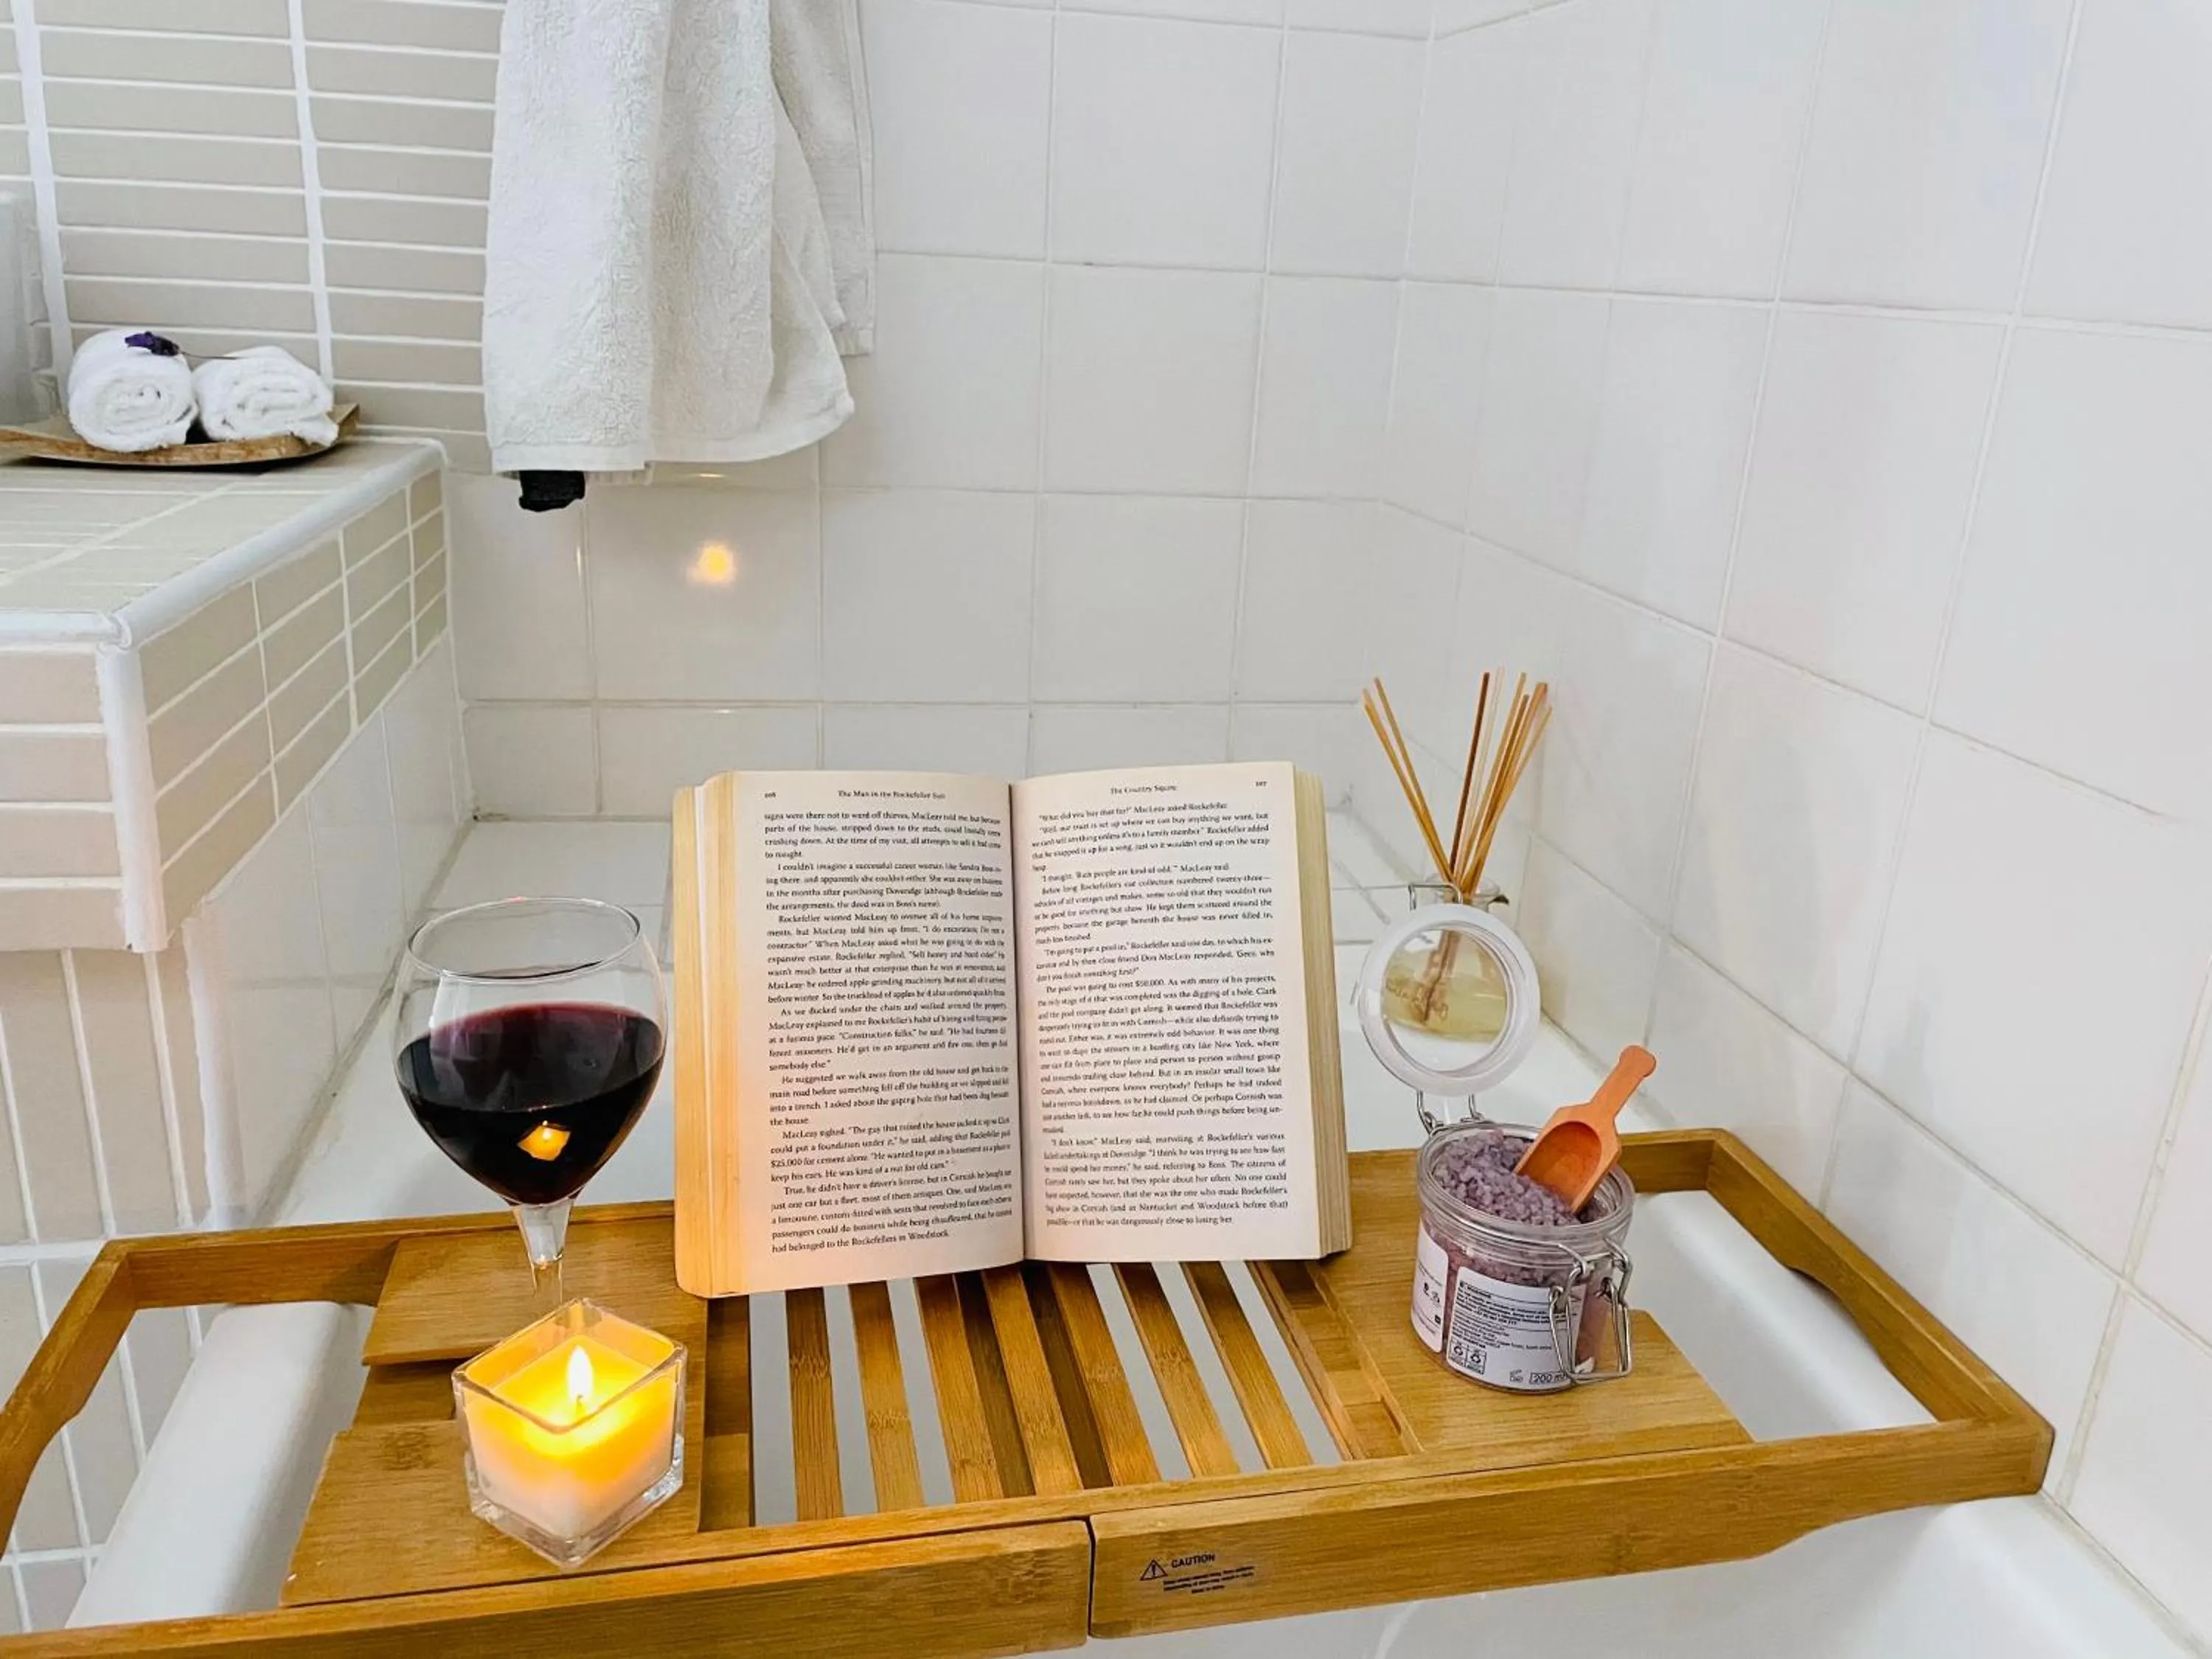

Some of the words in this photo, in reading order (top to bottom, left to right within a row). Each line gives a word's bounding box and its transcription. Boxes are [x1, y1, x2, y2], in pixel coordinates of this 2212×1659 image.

[1187, 815, 1220, 824] anything
[764, 825, 785, 834] parts
[786, 824, 796, 832] of
[782, 862, 814, 870] couldn't
[1206, 888, 1222, 897] they
[854, 964, 869, 973] that
[1124, 991, 1161, 1001] completed
[808, 1006, 837, 1014] ducked
[880, 1004, 902, 1012] chain
[804, 1018, 843, 1030] explained
[1166, 1029, 1181, 1037] odd
[1258, 1026, 1279, 1035] thing
[768, 1061, 809, 1071] somebody
[1122, 1057, 1142, 1067] place
[1197, 1055, 1223, 1063] person
[1222, 1066, 1244, 1074] small
[781, 1076, 793, 1084] He
[795, 1074, 834, 1084] suggested
[792, 1088, 810, 1096] road
[811, 1087, 837, 1095] before
[838, 1085, 879, 1094] something
[905, 1082, 918, 1090] the
[1203, 1093, 1234, 1103] perhaps
[1234, 1093, 1266, 1101] Cornish
[1176, 1107, 1195, 1118] push
[782, 1130, 818, 1138] MacLeay
[1206, 1133, 1253, 1141] Rockefeller's
[770, 1144, 793, 1153] could
[795, 1145, 809, 1154] put
[817, 1141, 860, 1150] foundation
[803, 1157, 815, 1165] for
[886, 1150, 914, 1159] wanted
[1230, 1160, 1245, 1168] The
[771, 1174, 790, 1183] keep
[916, 1162, 928, 1171] old
[1264, 1172, 1287, 1180] could
[817, 1183, 841, 1192] didn't
[842, 1182, 861, 1190] have
[1240, 1186, 1287, 1194] Rockefeller's
[818, 1198, 832, 1206] but
[1197, 1201, 1240, 1209] Woodstock
[1242, 1200, 1267, 1208] before
[874, 1206, 892, 1215] with
[1120, 1217, 1164, 1226] dangerously
[771, 1229, 815, 1239] passengers
[815, 1225, 838, 1234] could
[840, 1224, 851, 1232] do
[771, 1243, 787, 1253] had
[788, 1240, 825, 1251] belonged
[836, 1238, 849, 1247] the
[1172, 1553, 1215, 1568] CAUTION
